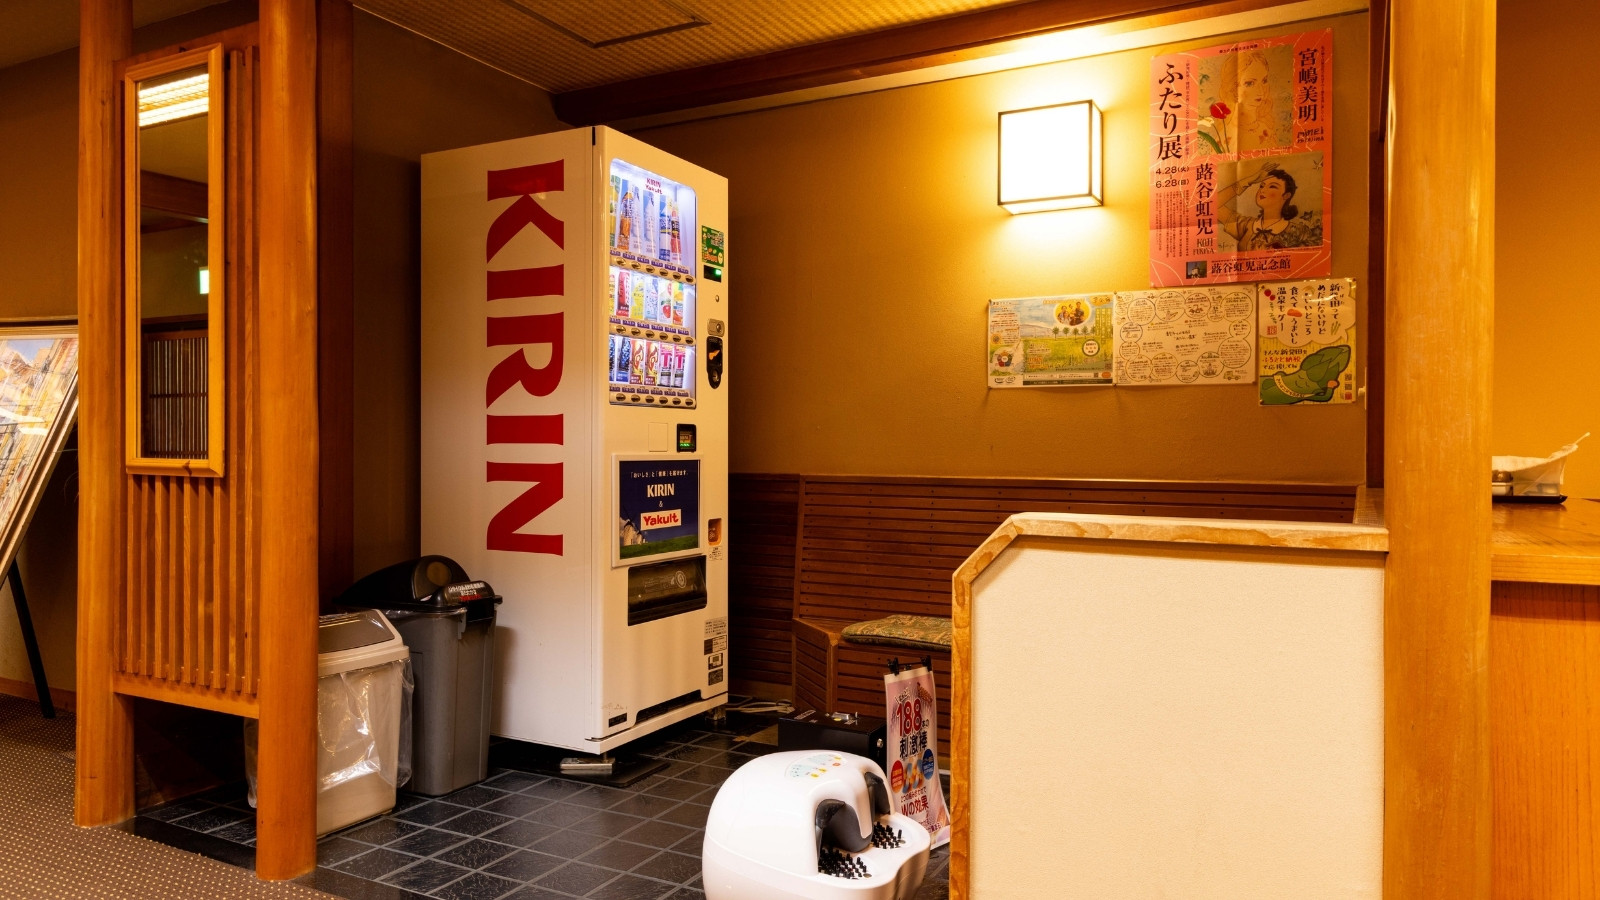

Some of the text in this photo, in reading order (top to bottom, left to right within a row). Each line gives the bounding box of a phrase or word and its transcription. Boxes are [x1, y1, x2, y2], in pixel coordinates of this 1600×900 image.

[1298, 48, 1318, 122] 宮嶋美明
[1157, 63, 1183, 160] ふたり展
[646, 177, 661, 188] KIRIN
[1196, 163, 1214, 236] 蕗谷虹児
[1290, 286, 1299, 308] 食べて
[486, 158, 564, 556] KIRIN
[647, 483, 675, 498] KIRIN
[658, 500, 664, 508] &
[643, 512, 680, 527] Yakult
[899, 731, 928, 759] 刺激棒
[901, 795, 929, 817] Wの効果
